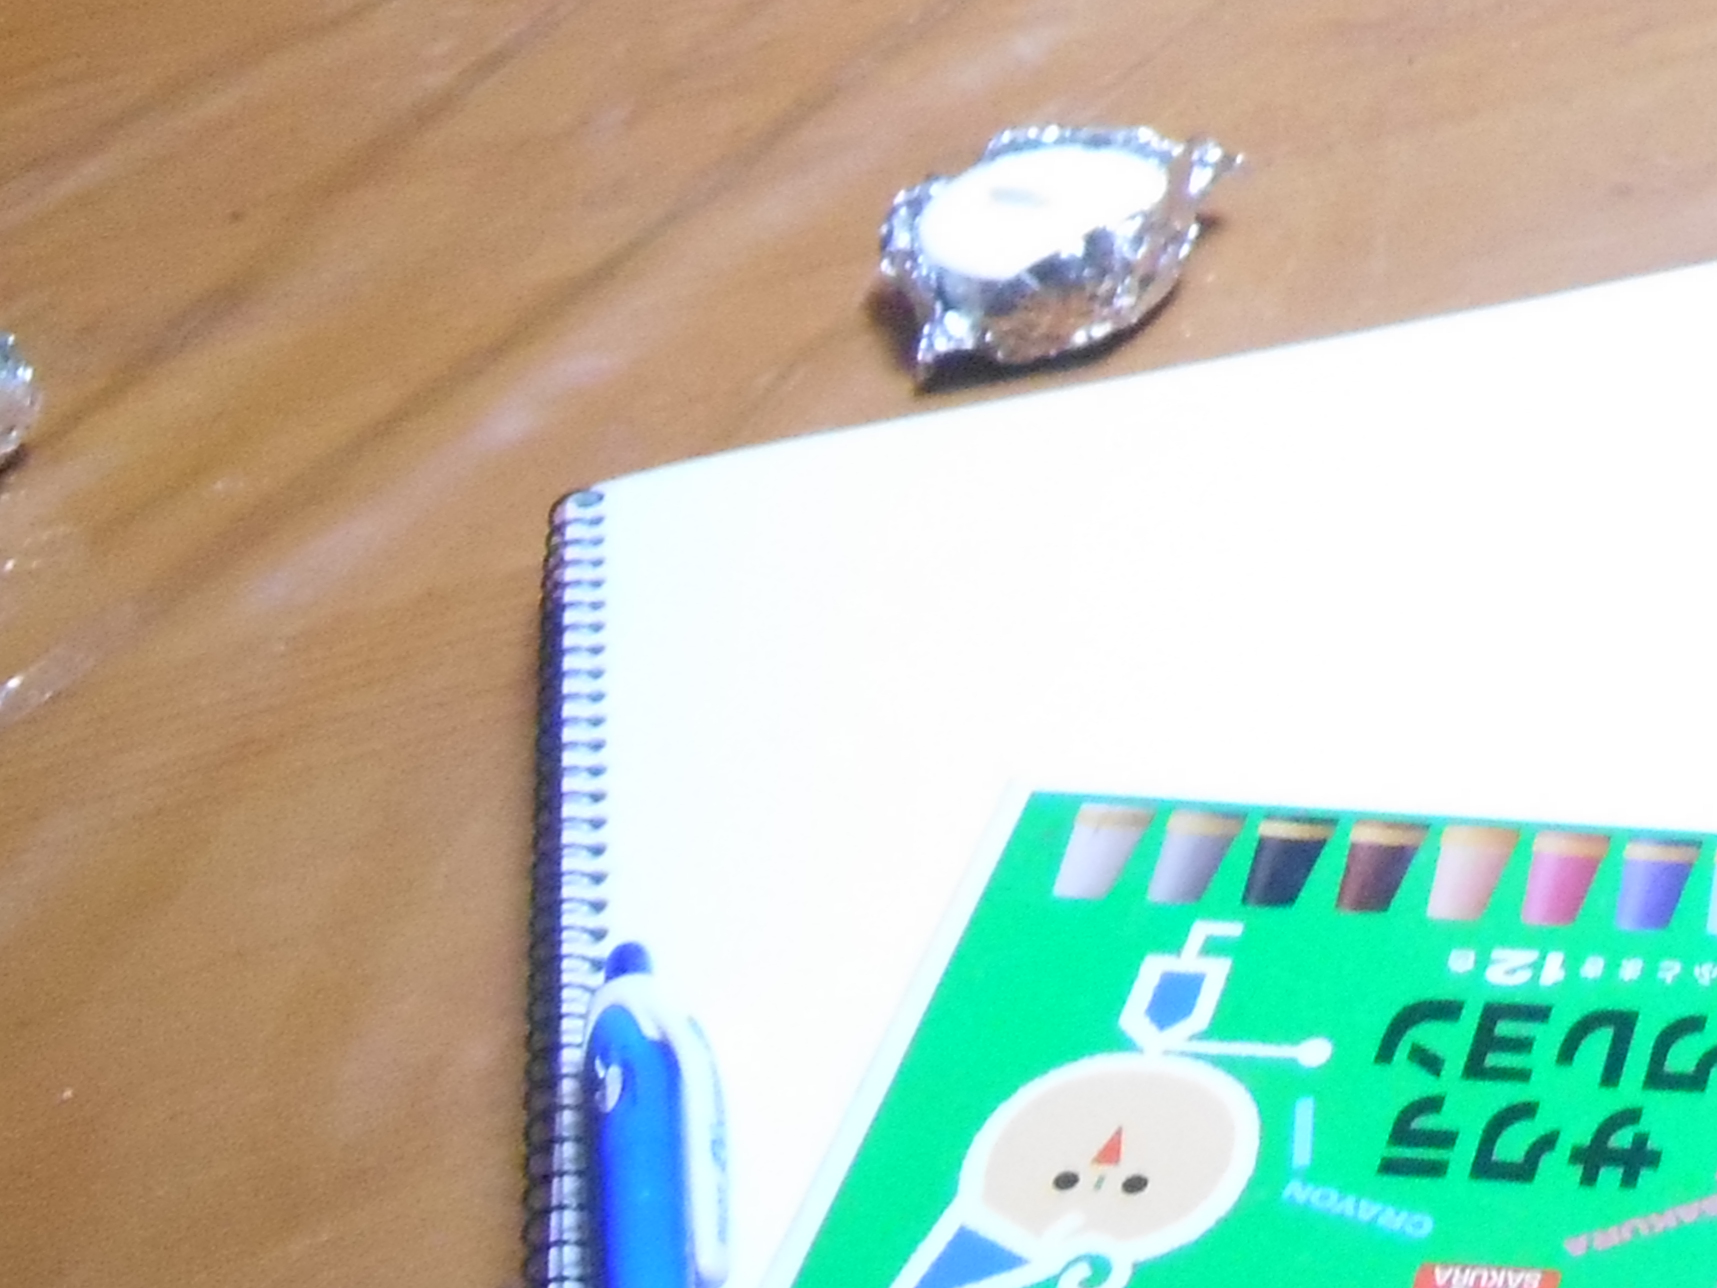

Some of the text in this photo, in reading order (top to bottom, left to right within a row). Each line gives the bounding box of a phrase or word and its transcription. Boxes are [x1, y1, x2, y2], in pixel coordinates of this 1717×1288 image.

[1377, 1095, 1663, 1189] サクラ
[1281, 1179, 1434, 1240] CRAYON
[1433, 1264, 1556, 1288] SAKURA
